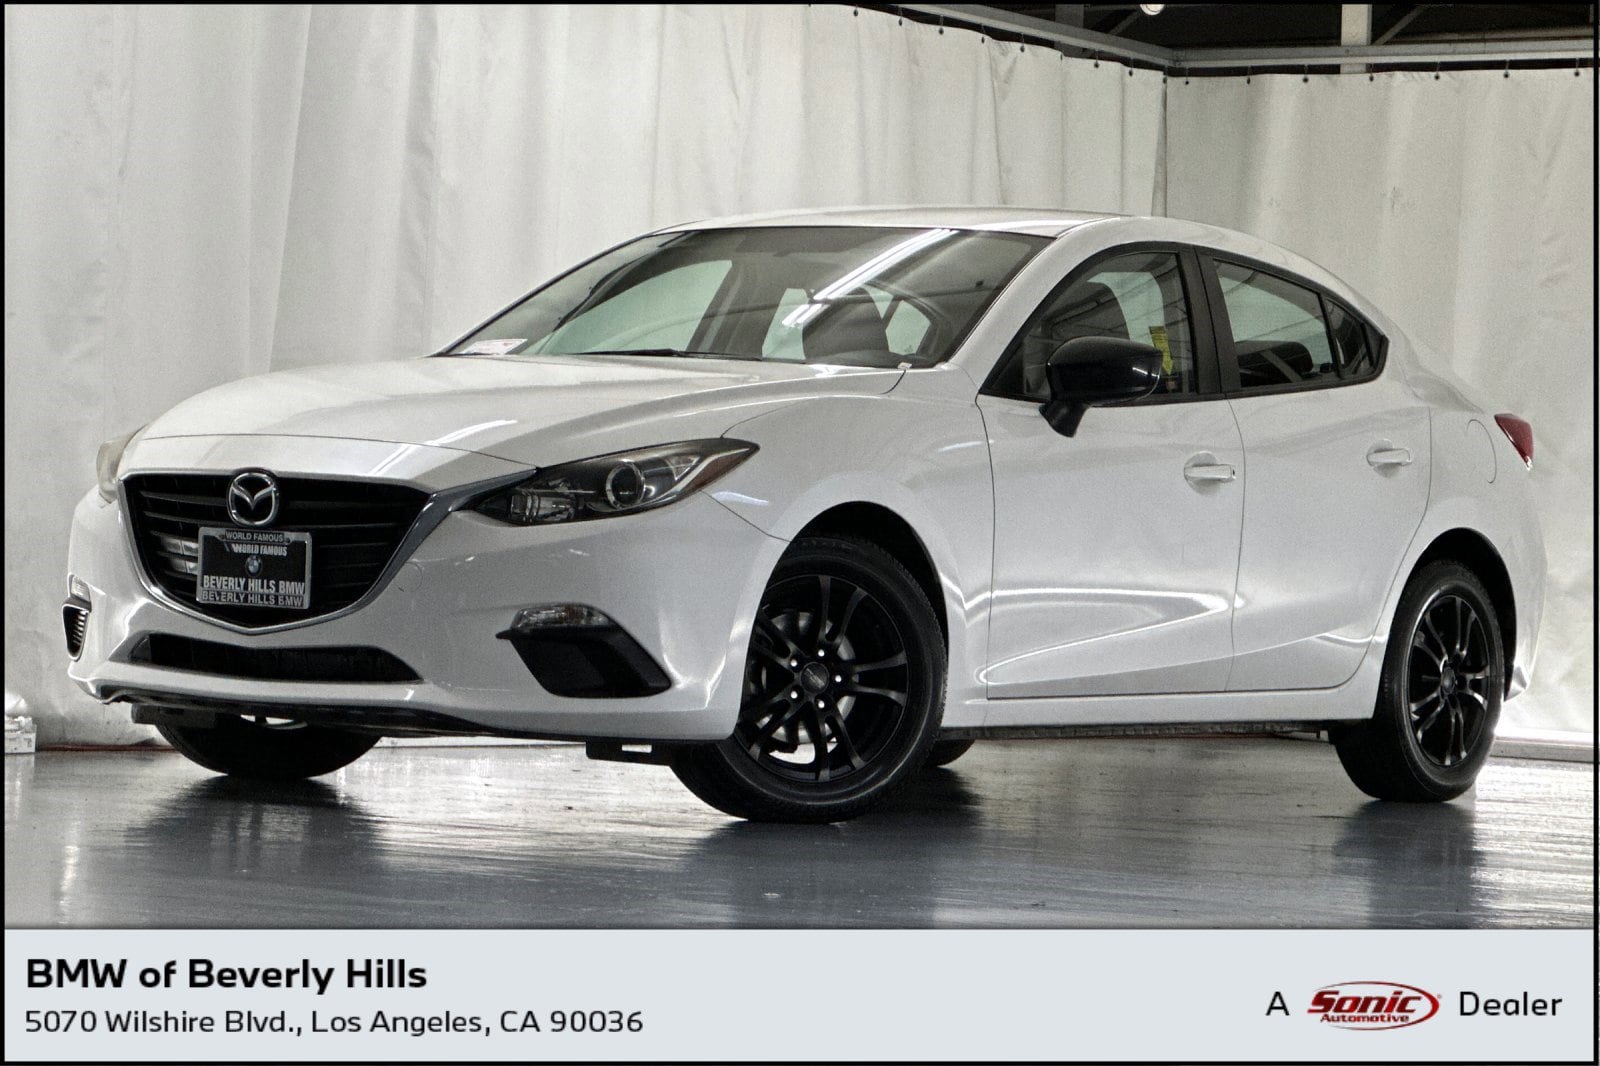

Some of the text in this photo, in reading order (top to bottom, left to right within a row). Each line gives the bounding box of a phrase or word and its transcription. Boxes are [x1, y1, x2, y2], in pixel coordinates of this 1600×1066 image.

[225, 531, 284, 543] WORLD FAMOUS
[231, 543, 288, 557] WORLD FAMOUS
[203, 575, 305, 596] BEVERLY HILLS BMW
[202, 590, 303, 607] BEVERLY HILLS BMW
